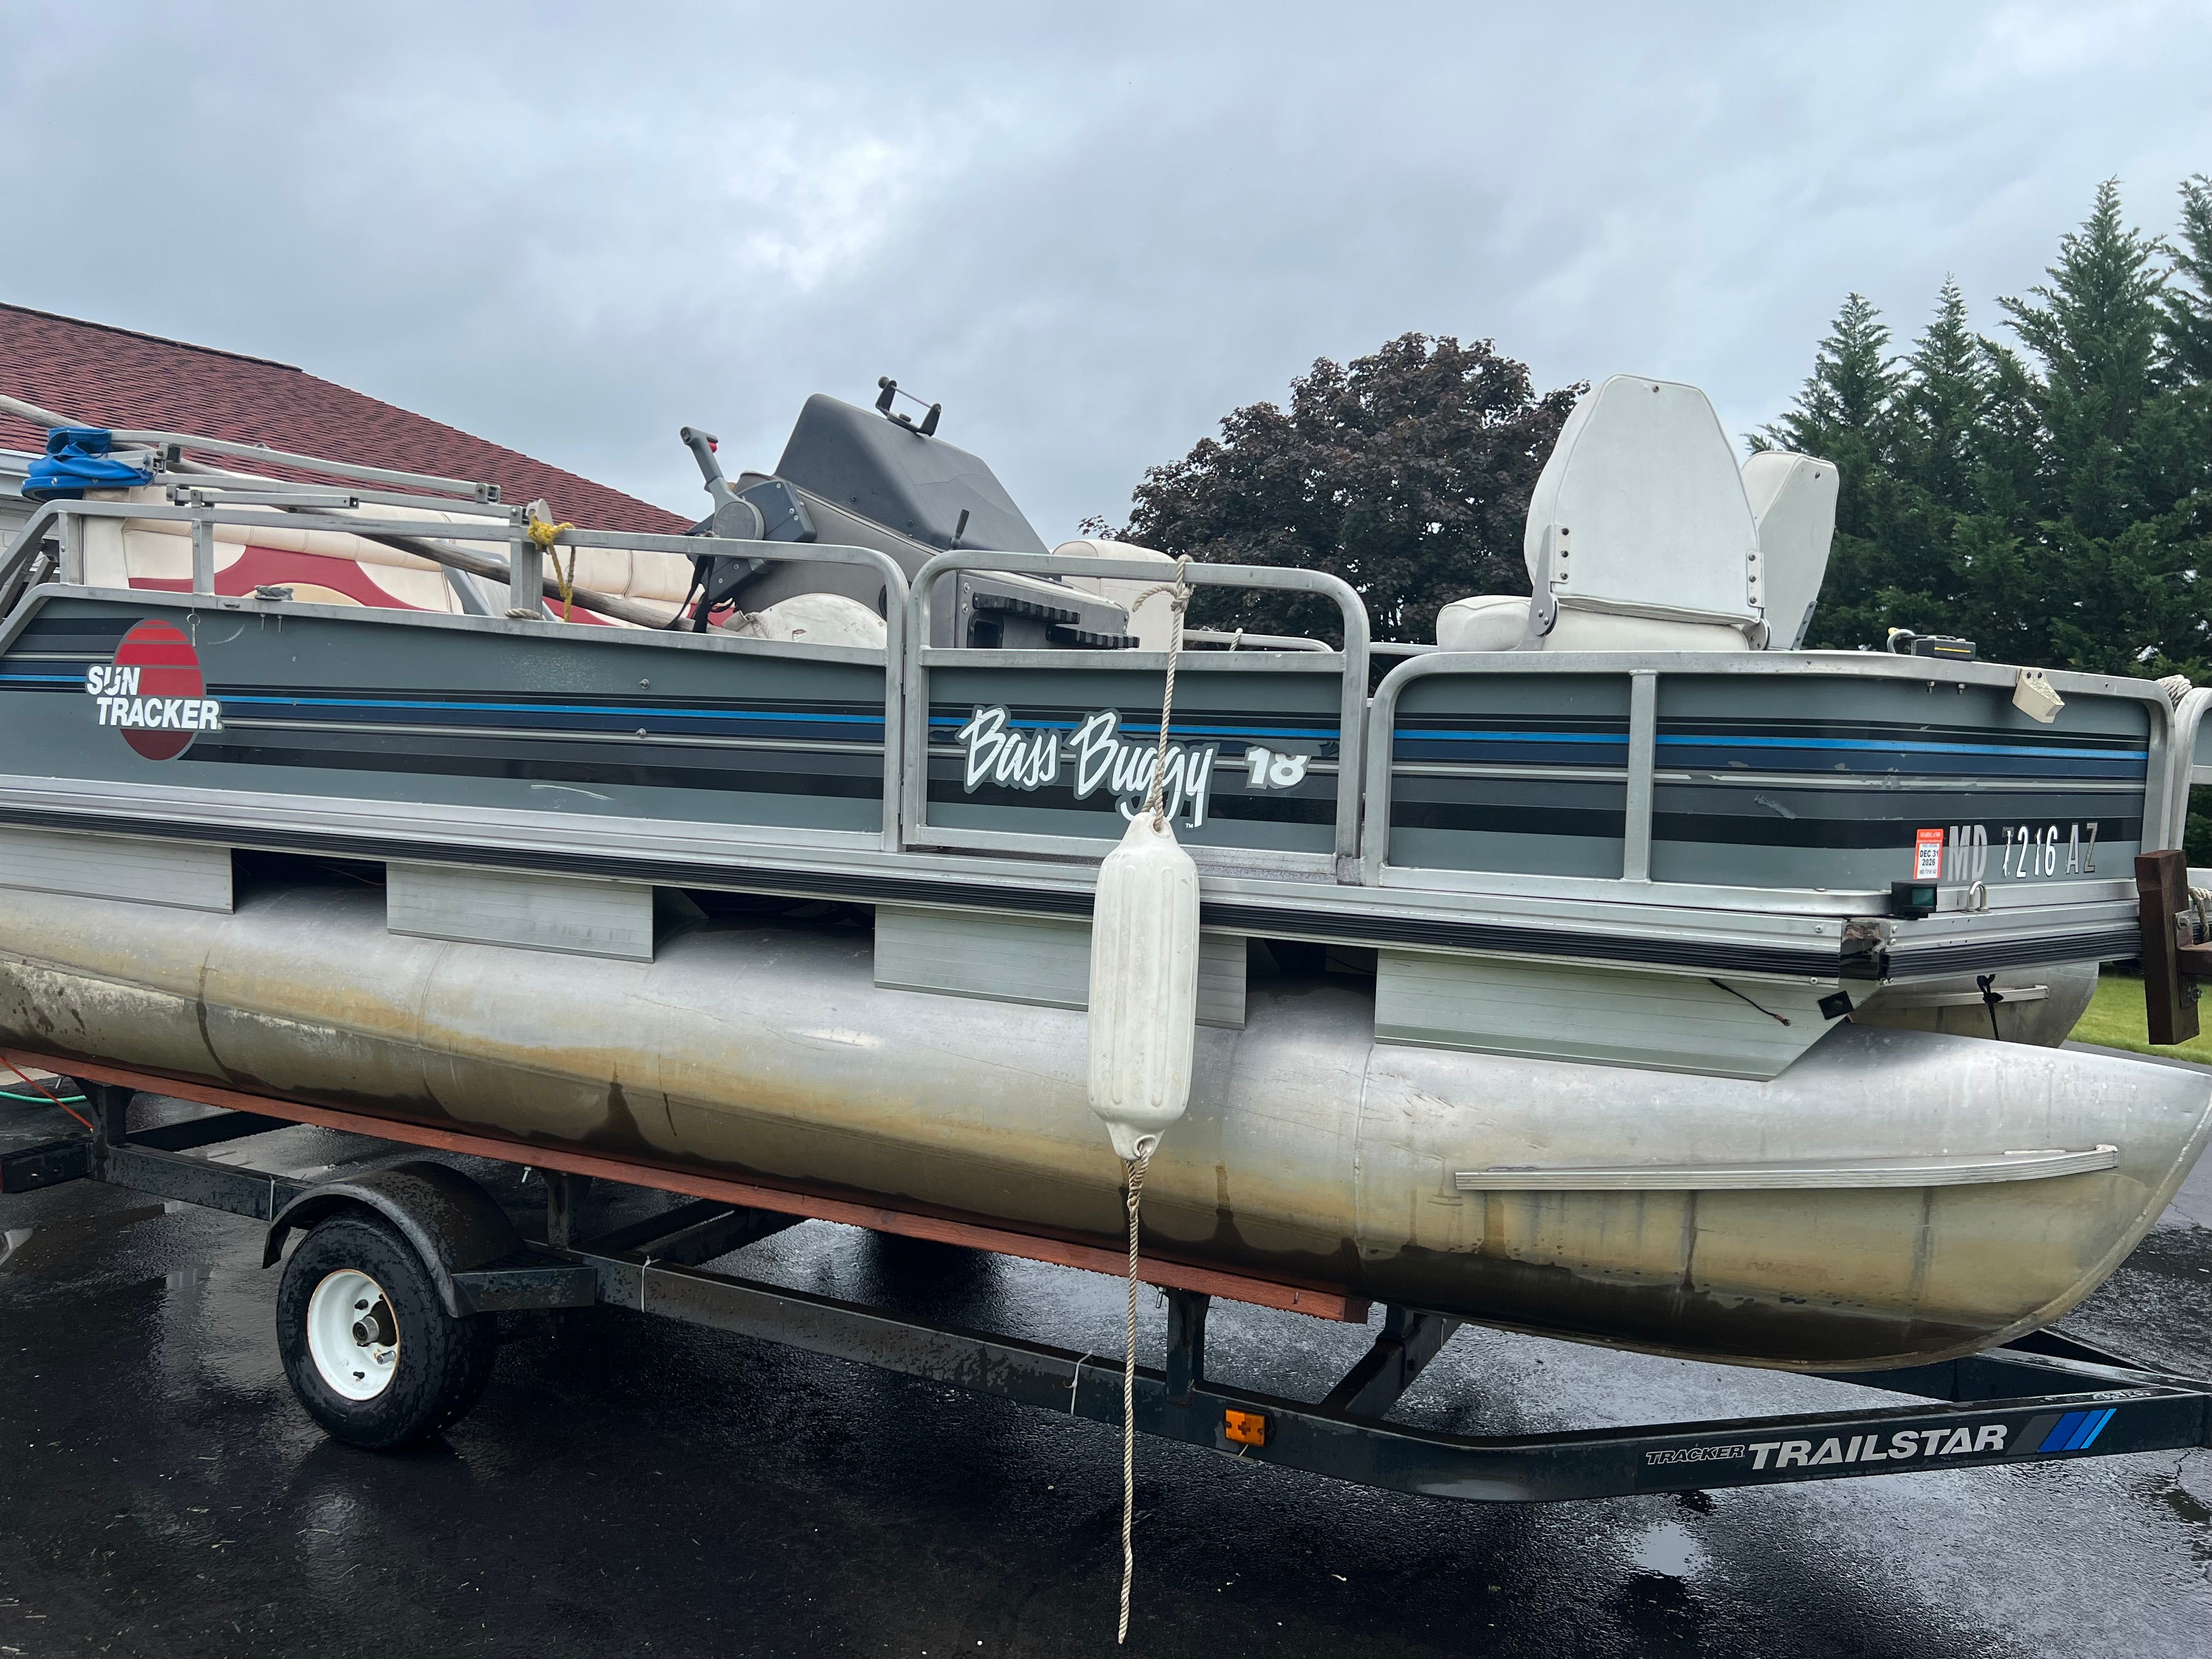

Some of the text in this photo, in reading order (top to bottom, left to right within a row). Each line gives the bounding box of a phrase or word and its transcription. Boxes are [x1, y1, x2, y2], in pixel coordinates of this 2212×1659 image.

[87, 665, 140, 696] SUN
[97, 697, 220, 730] TRACKER
[958, 707, 1308, 827] Bass Buggy 18
[1947, 824, 1988, 882] MD
[2065, 822, 2098, 874] AZ
[1646, 1424, 2007, 1470] TRACKER TRAILSTAR
